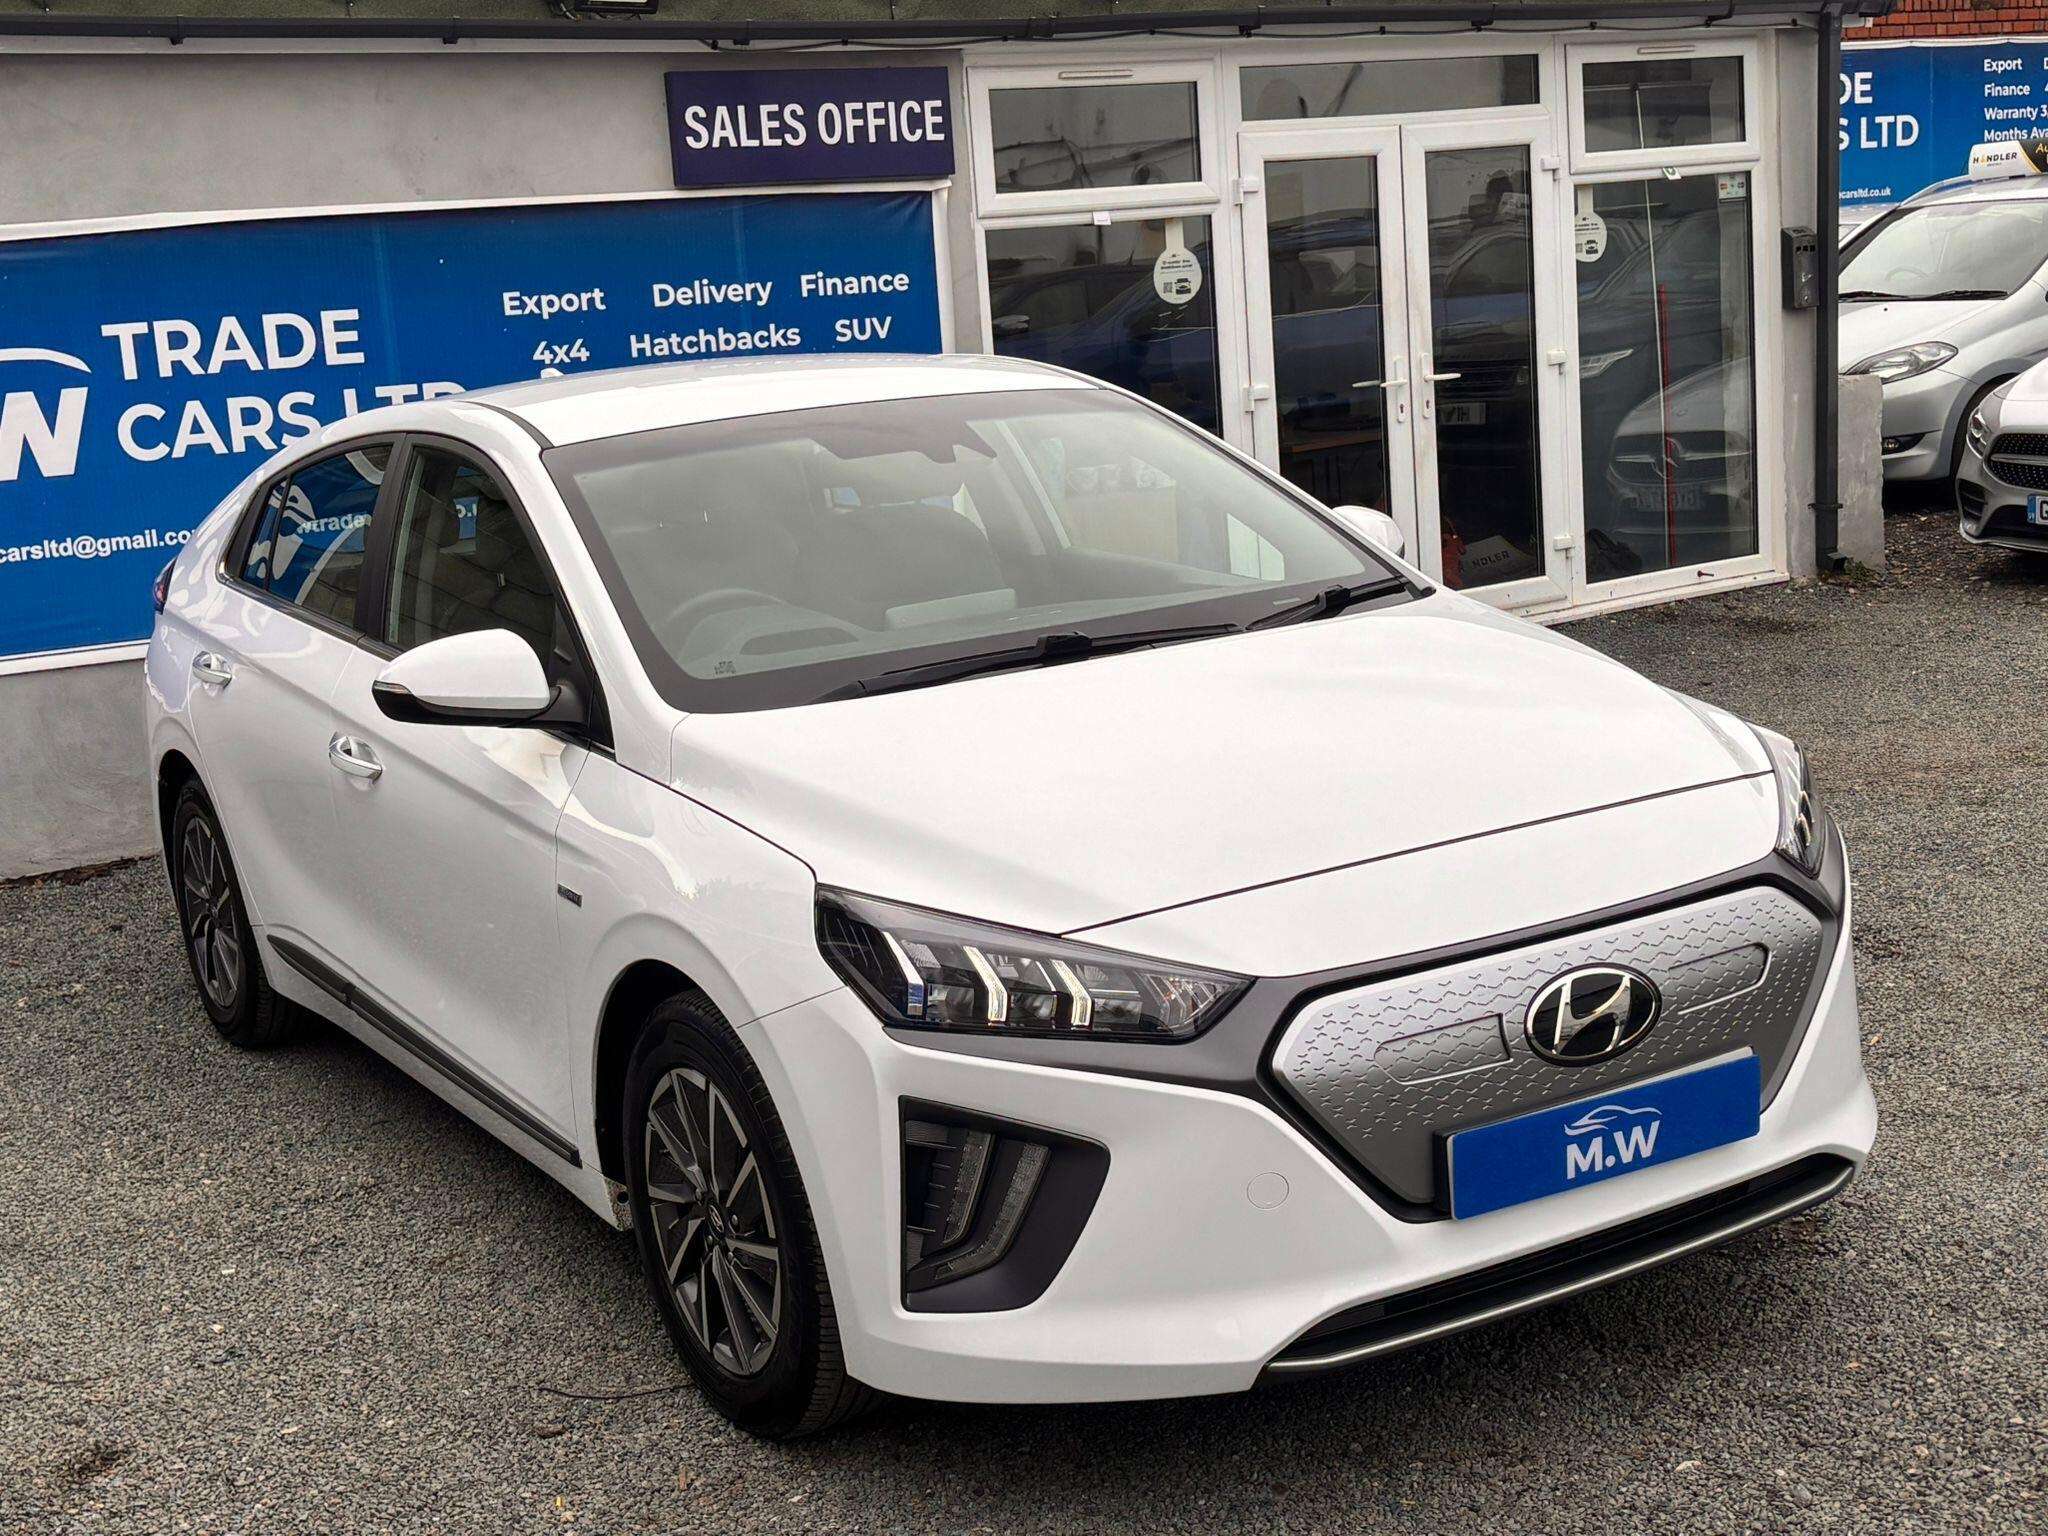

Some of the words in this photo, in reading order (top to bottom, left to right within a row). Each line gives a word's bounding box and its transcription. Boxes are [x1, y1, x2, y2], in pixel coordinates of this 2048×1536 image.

[1983, 57, 2023, 73] Export
[1984, 83, 2030, 98] Finance
[685, 102, 807, 149] SALES
[817, 100, 945, 145] OFFICE
[1860, 114, 1920, 149] LTD
[1984, 105, 2038, 121] Warranty
[1984, 126, 2028, 143] Months
[503, 287, 607, 319] Export
[652, 279, 773, 308] Delivery
[800, 270, 910, 298] Finance
[101, 308, 365, 381] TRADE
[532, 338, 590, 365] 4x4
[629, 322, 801, 358] Hatchbacks
[834, 315, 892, 342] SUV
[117, 391, 321, 462] CARS
[0, 529, 197, 564] carsltd@gmail.co
[1566, 1119, 1661, 1180] M.W
